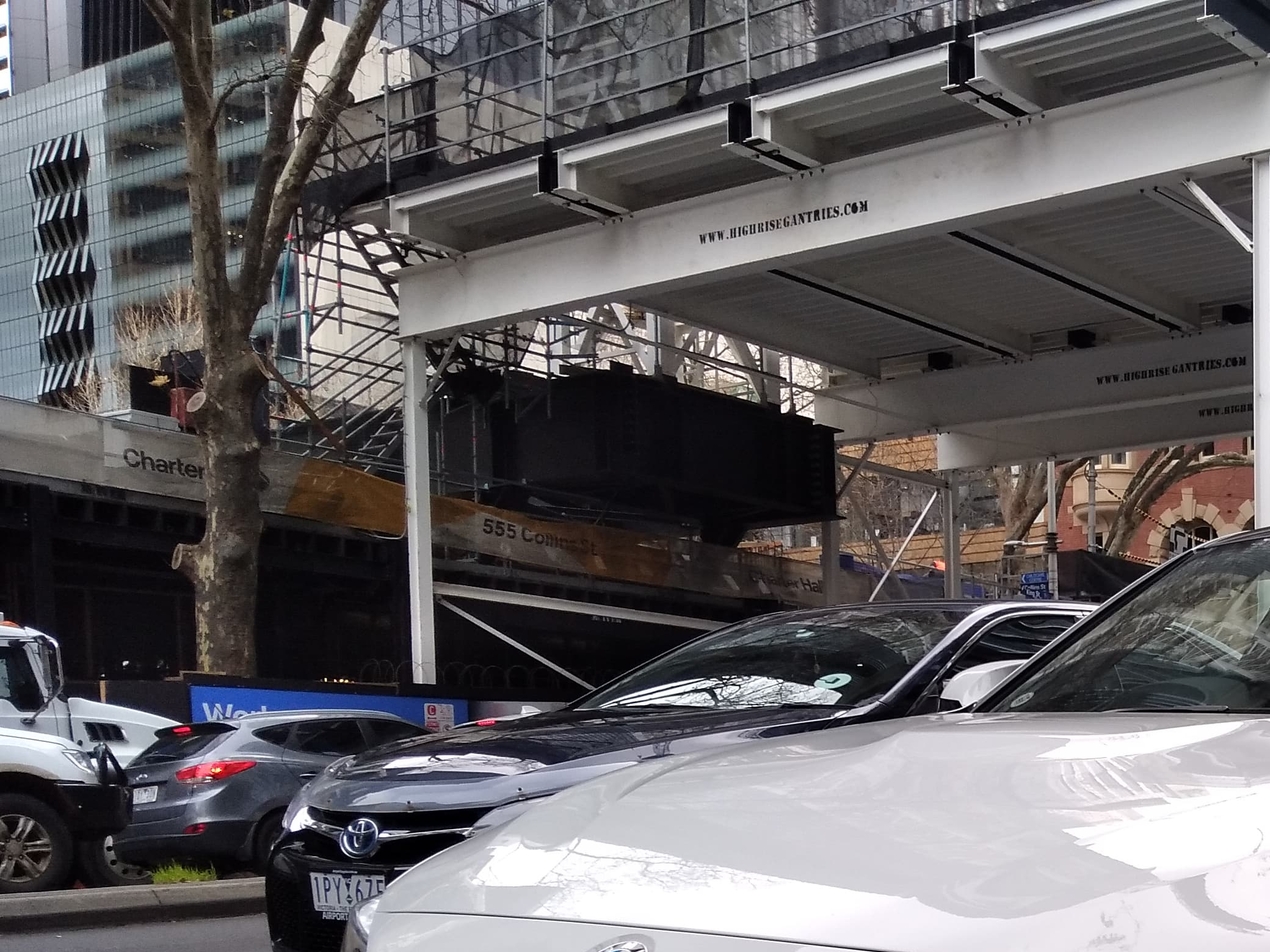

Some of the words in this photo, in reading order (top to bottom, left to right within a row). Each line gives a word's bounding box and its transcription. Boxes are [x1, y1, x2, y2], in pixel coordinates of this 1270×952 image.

[123, 447, 205, 479] Charter
[482, 519, 516, 539] 555
[799, 577, 823, 594] Hal
[314, 876, 341, 904] 1PY
[322, 911, 349, 921] AIRPORT
